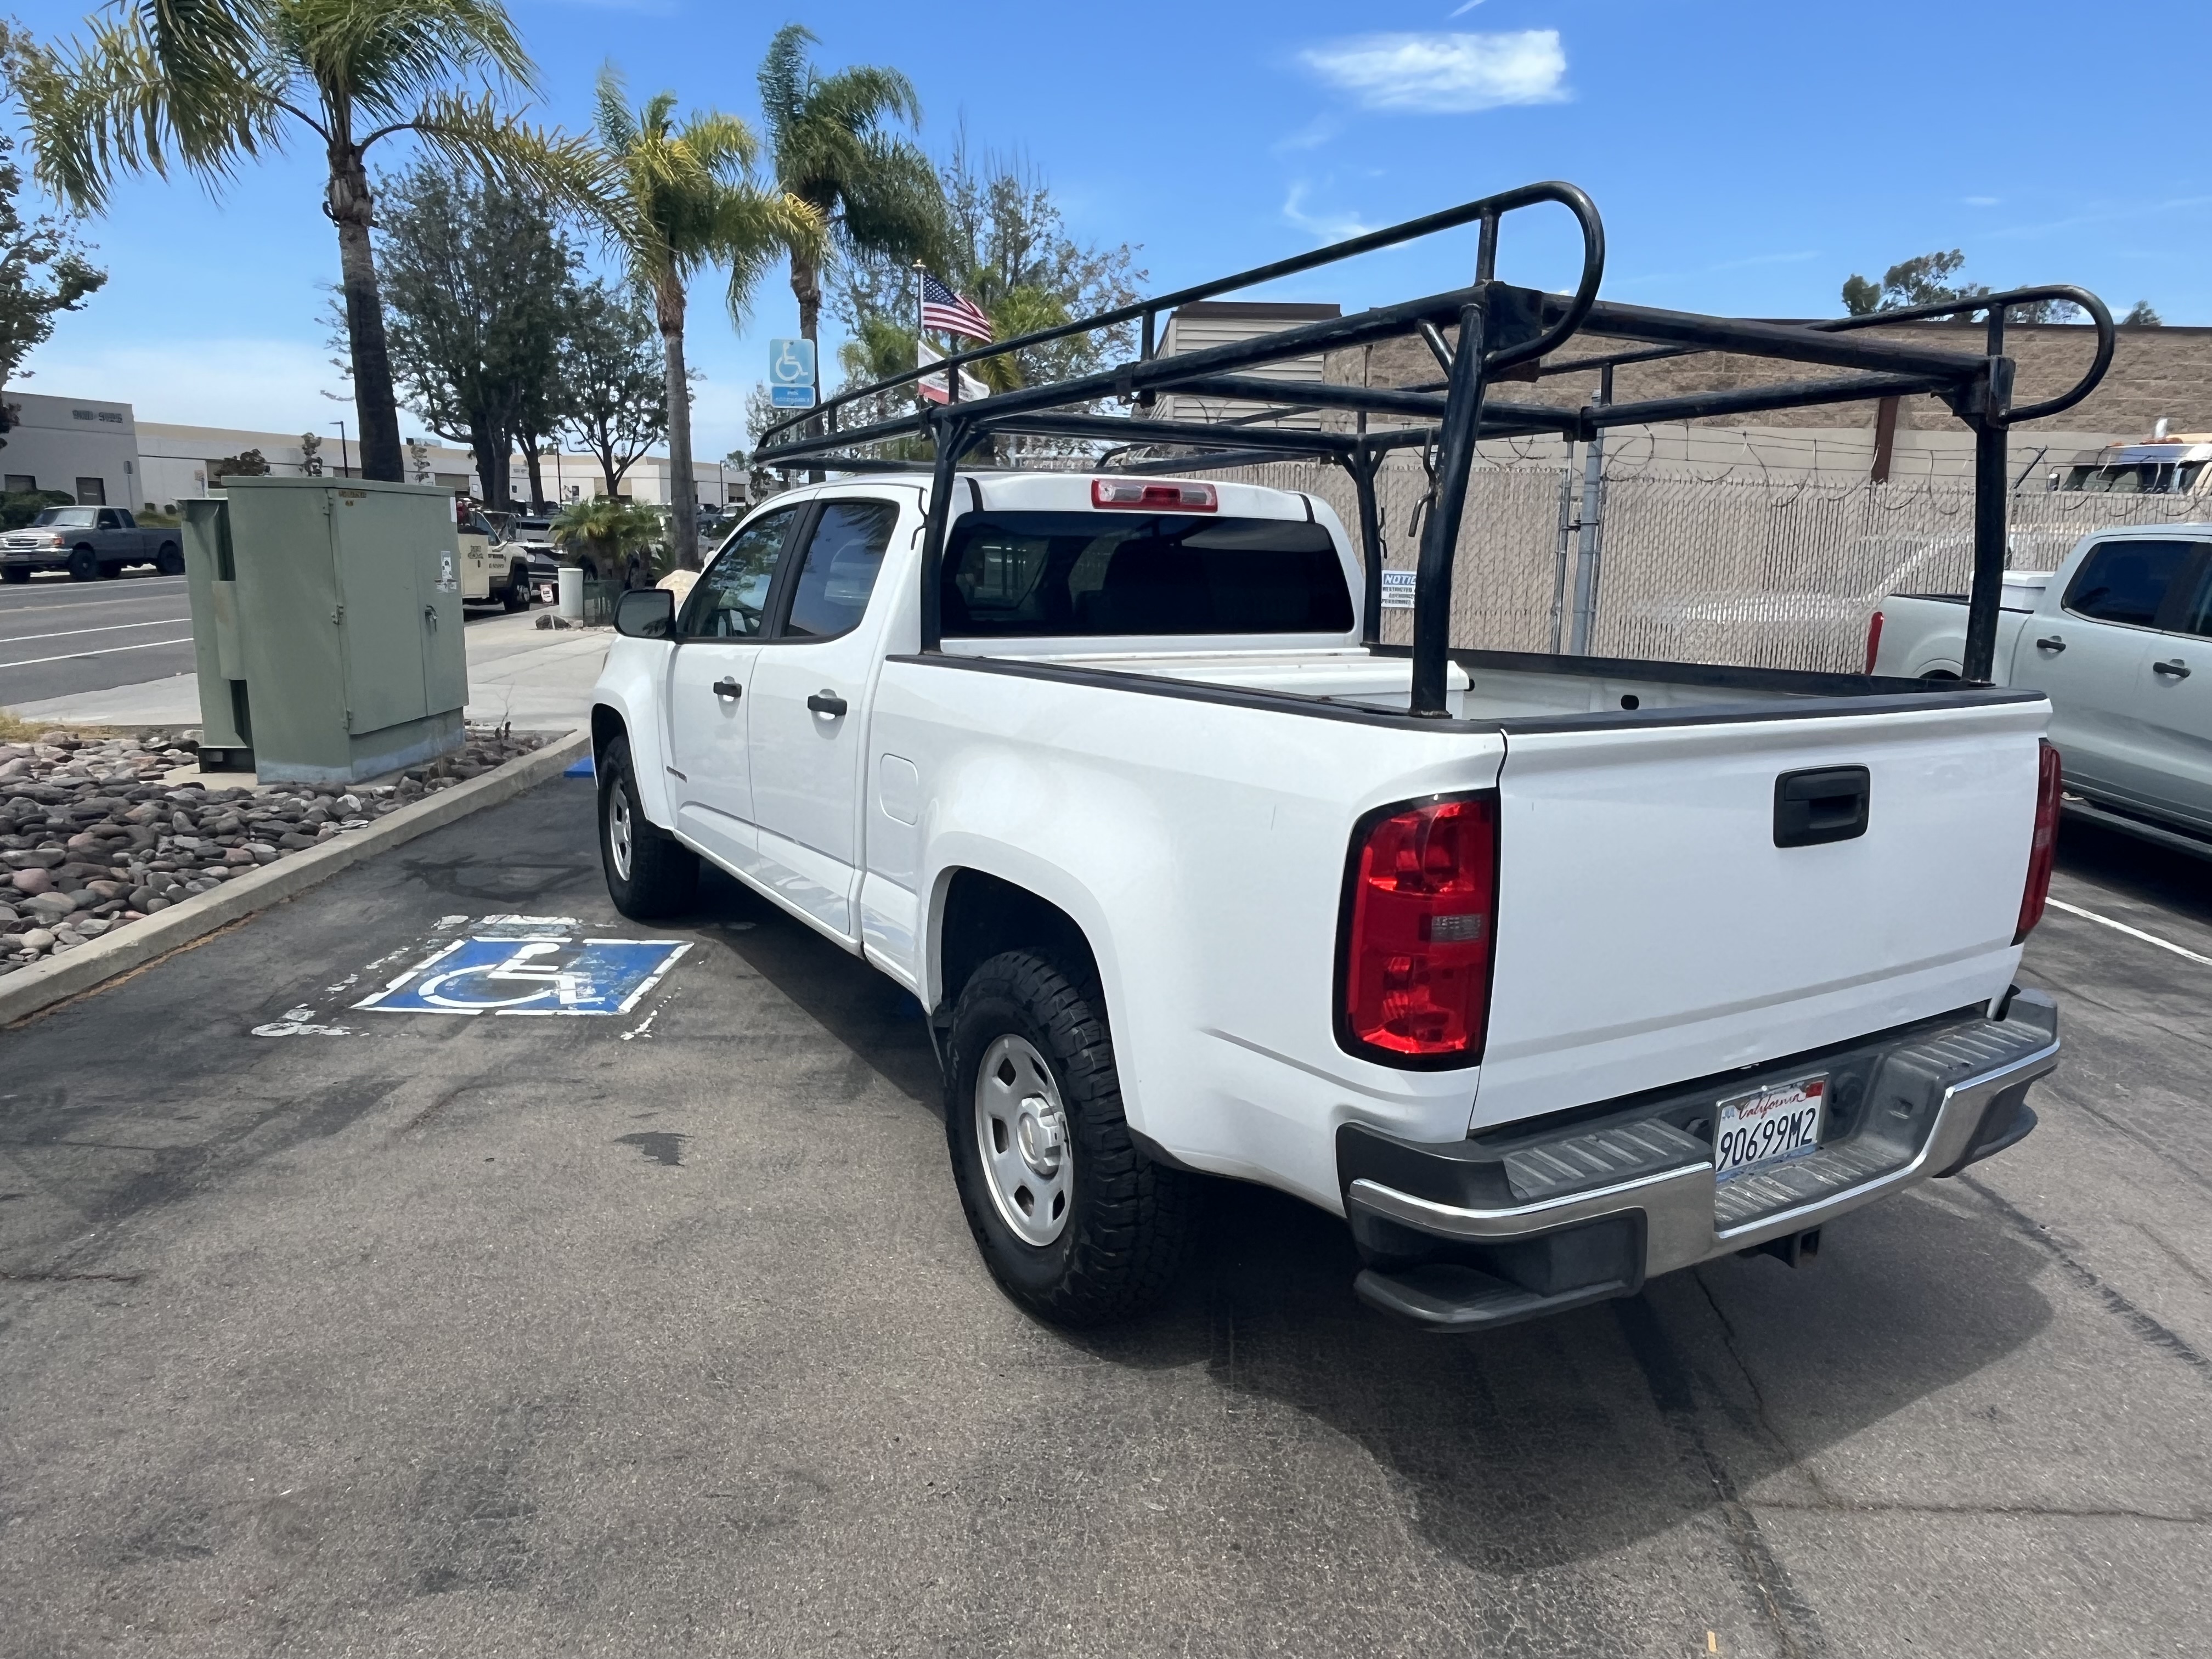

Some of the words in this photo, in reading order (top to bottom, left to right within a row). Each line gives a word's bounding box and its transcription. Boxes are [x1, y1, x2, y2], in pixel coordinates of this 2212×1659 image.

[1385, 574, 1416, 584] NOTIC
[1739, 1092, 1806, 1120] California
[1717, 1108, 1816, 1172] 90699M2
